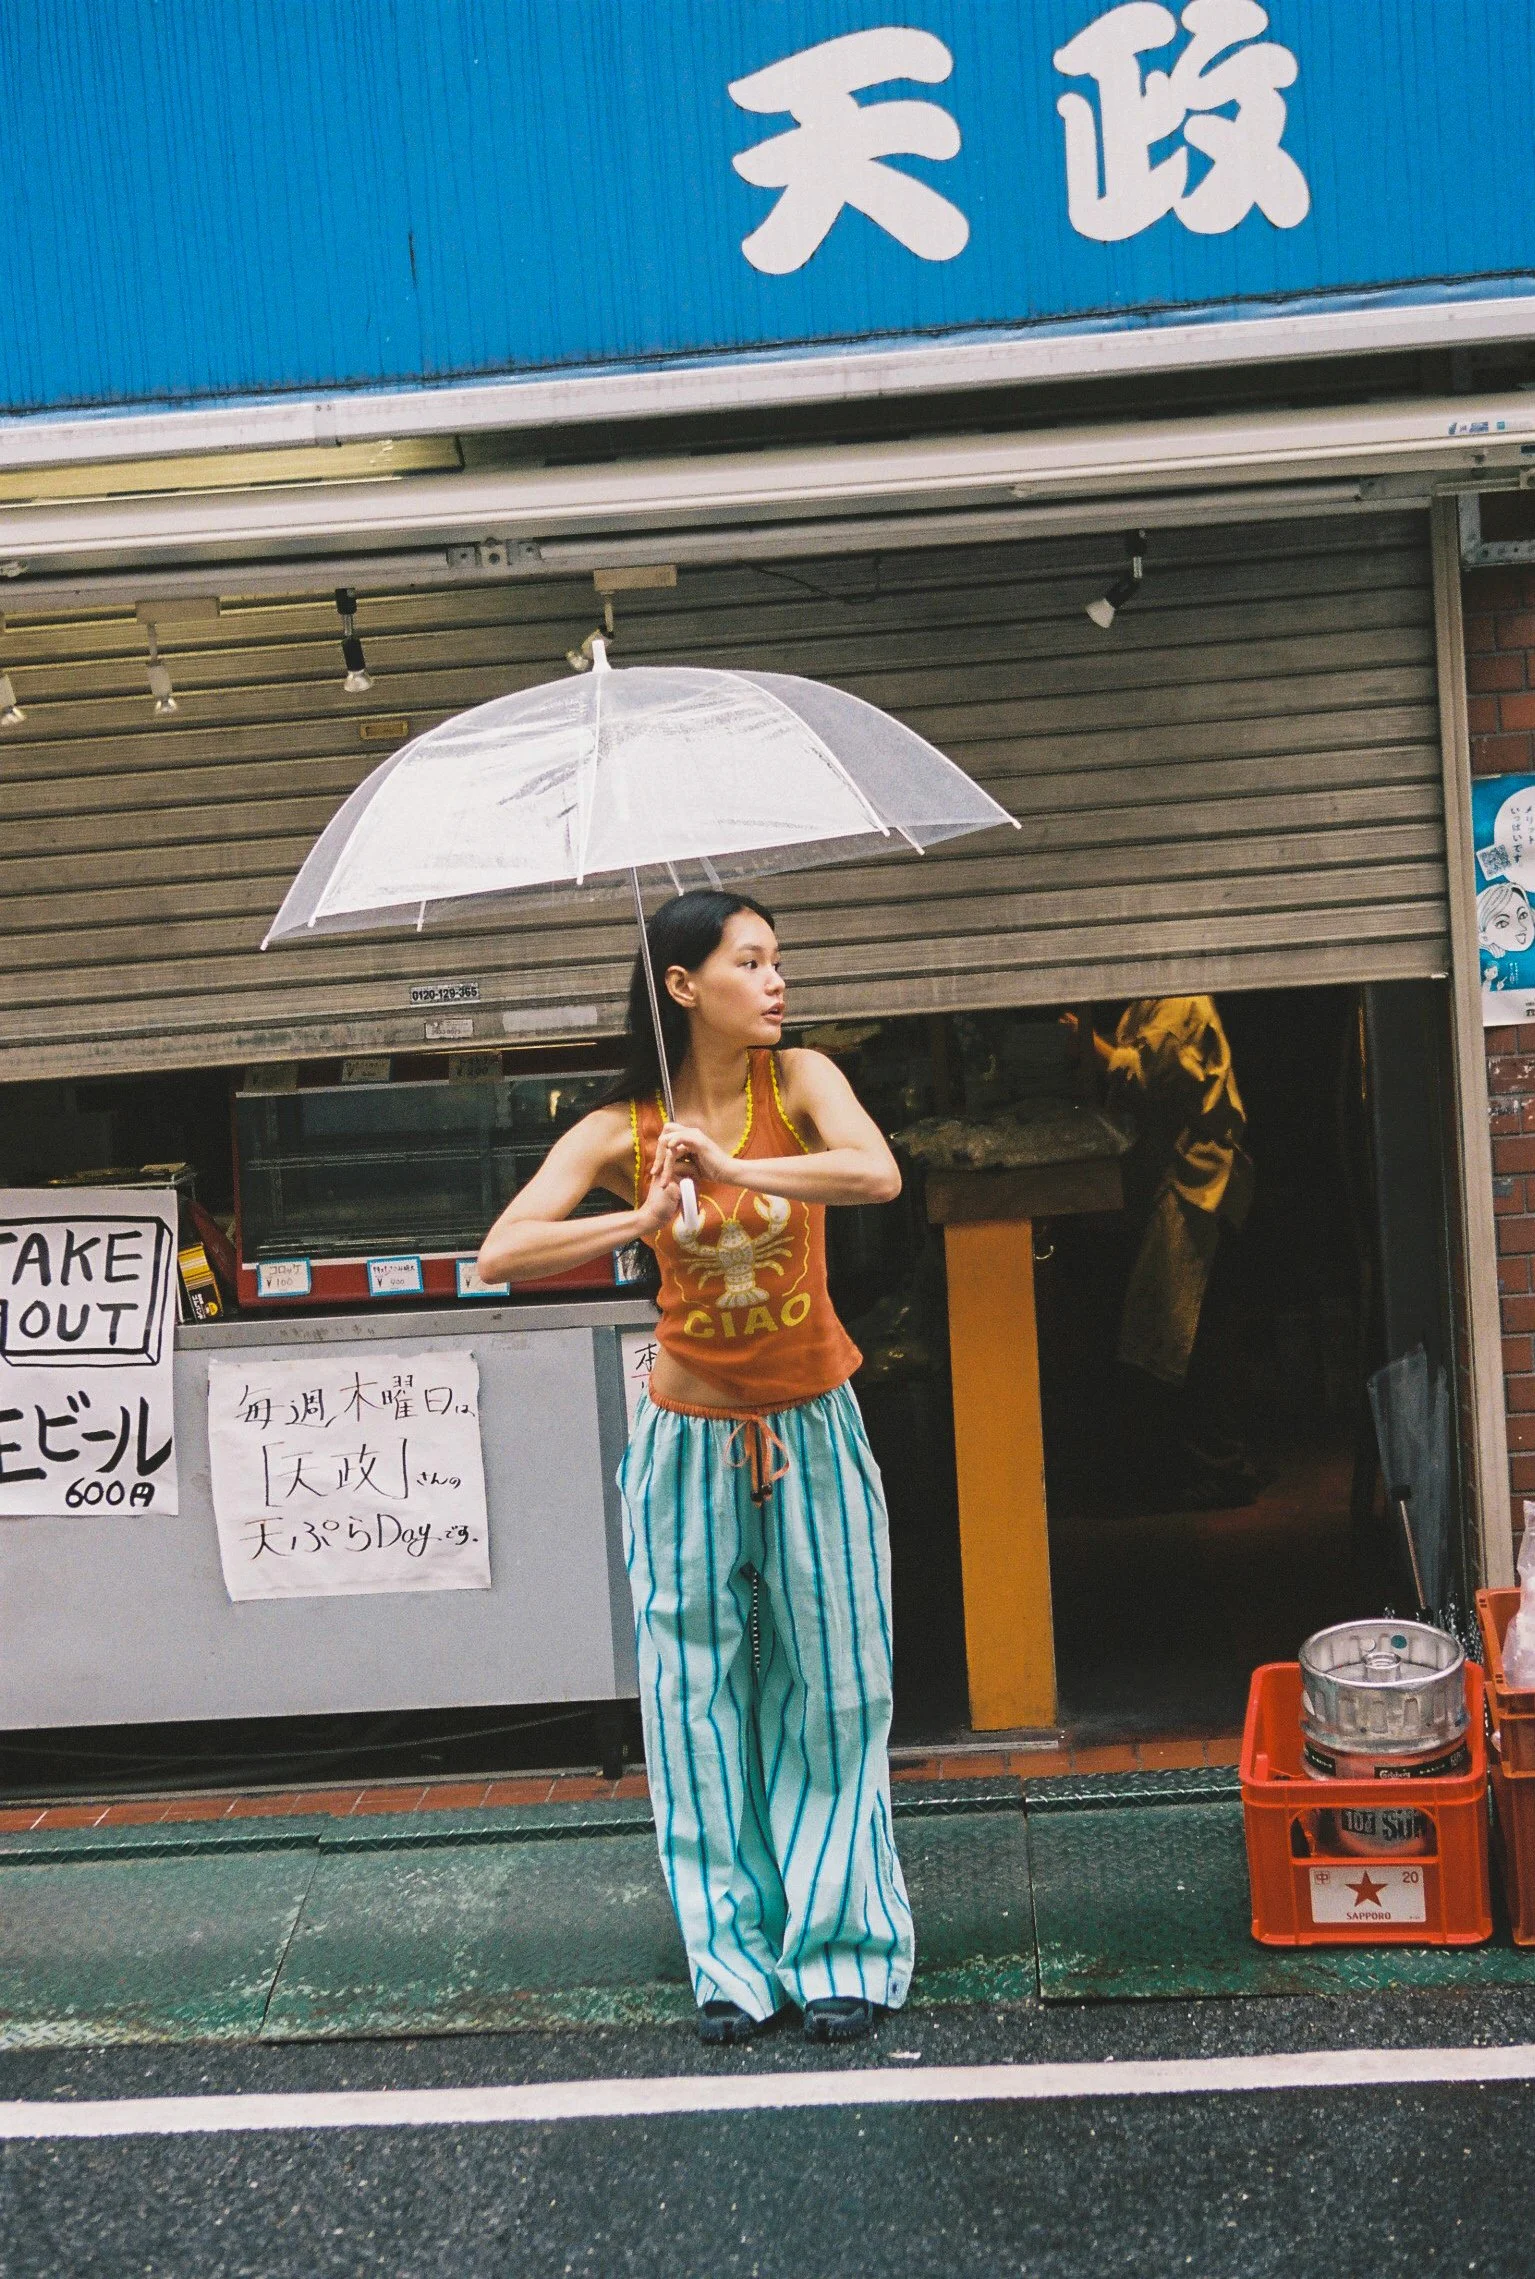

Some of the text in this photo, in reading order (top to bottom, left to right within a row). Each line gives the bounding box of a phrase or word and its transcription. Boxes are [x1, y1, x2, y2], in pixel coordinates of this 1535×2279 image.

[728, 0, 1311, 275] 天政
[411, 986, 478, 1001] 0120-129-365
[19, 1300, 139, 1346] OUT
[683, 1292, 811, 1338] CIAO
[234, 1371, 476, 1430] 毎週木曜日は
[65, 1476, 156, 1509] 600円
[1402, 1871, 1419, 1884] 20
[1346, 1912, 1391, 1920] SAPPORO
